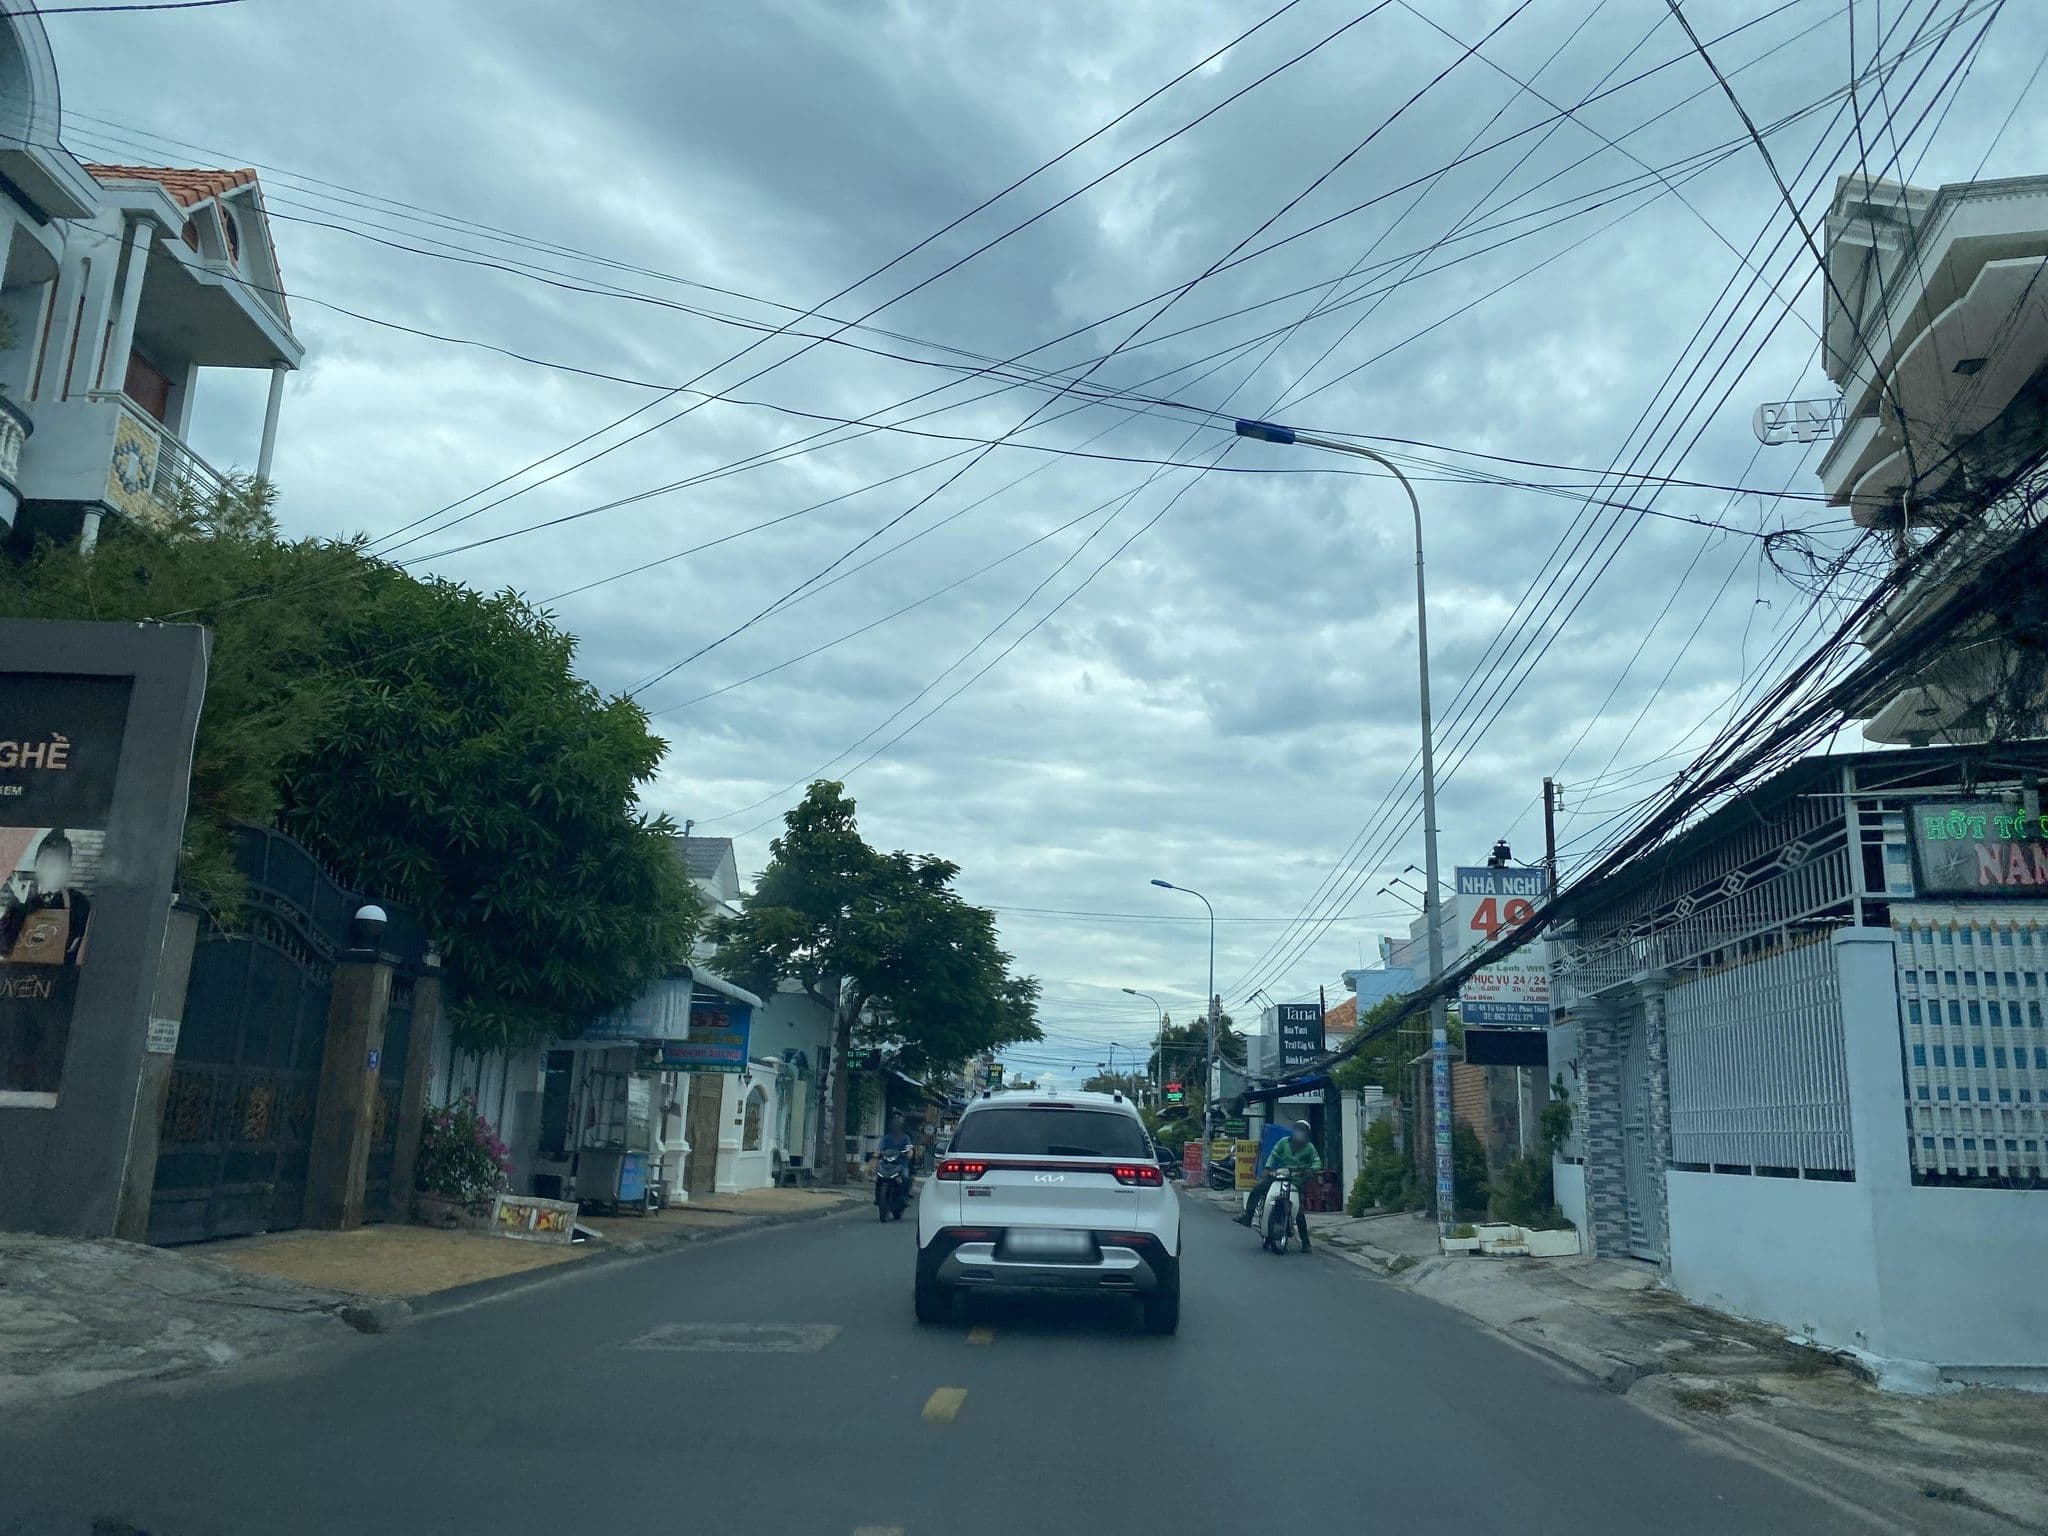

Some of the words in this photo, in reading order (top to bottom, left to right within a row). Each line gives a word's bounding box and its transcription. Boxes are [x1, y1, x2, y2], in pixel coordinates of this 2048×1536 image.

[1462, 872, 1496, 894] NHÀ
[1502, 872, 1542, 895] NGHỈ
[1470, 897, 1534, 941] 49
[1496, 975, 1509, 986] VỤ
[1513, 976, 1525, 985] 24
[1534, 976, 1546, 985] 24
[1284, 1006, 1316, 1021] Tana
[1034, 1174, 1064, 1182] KIA
